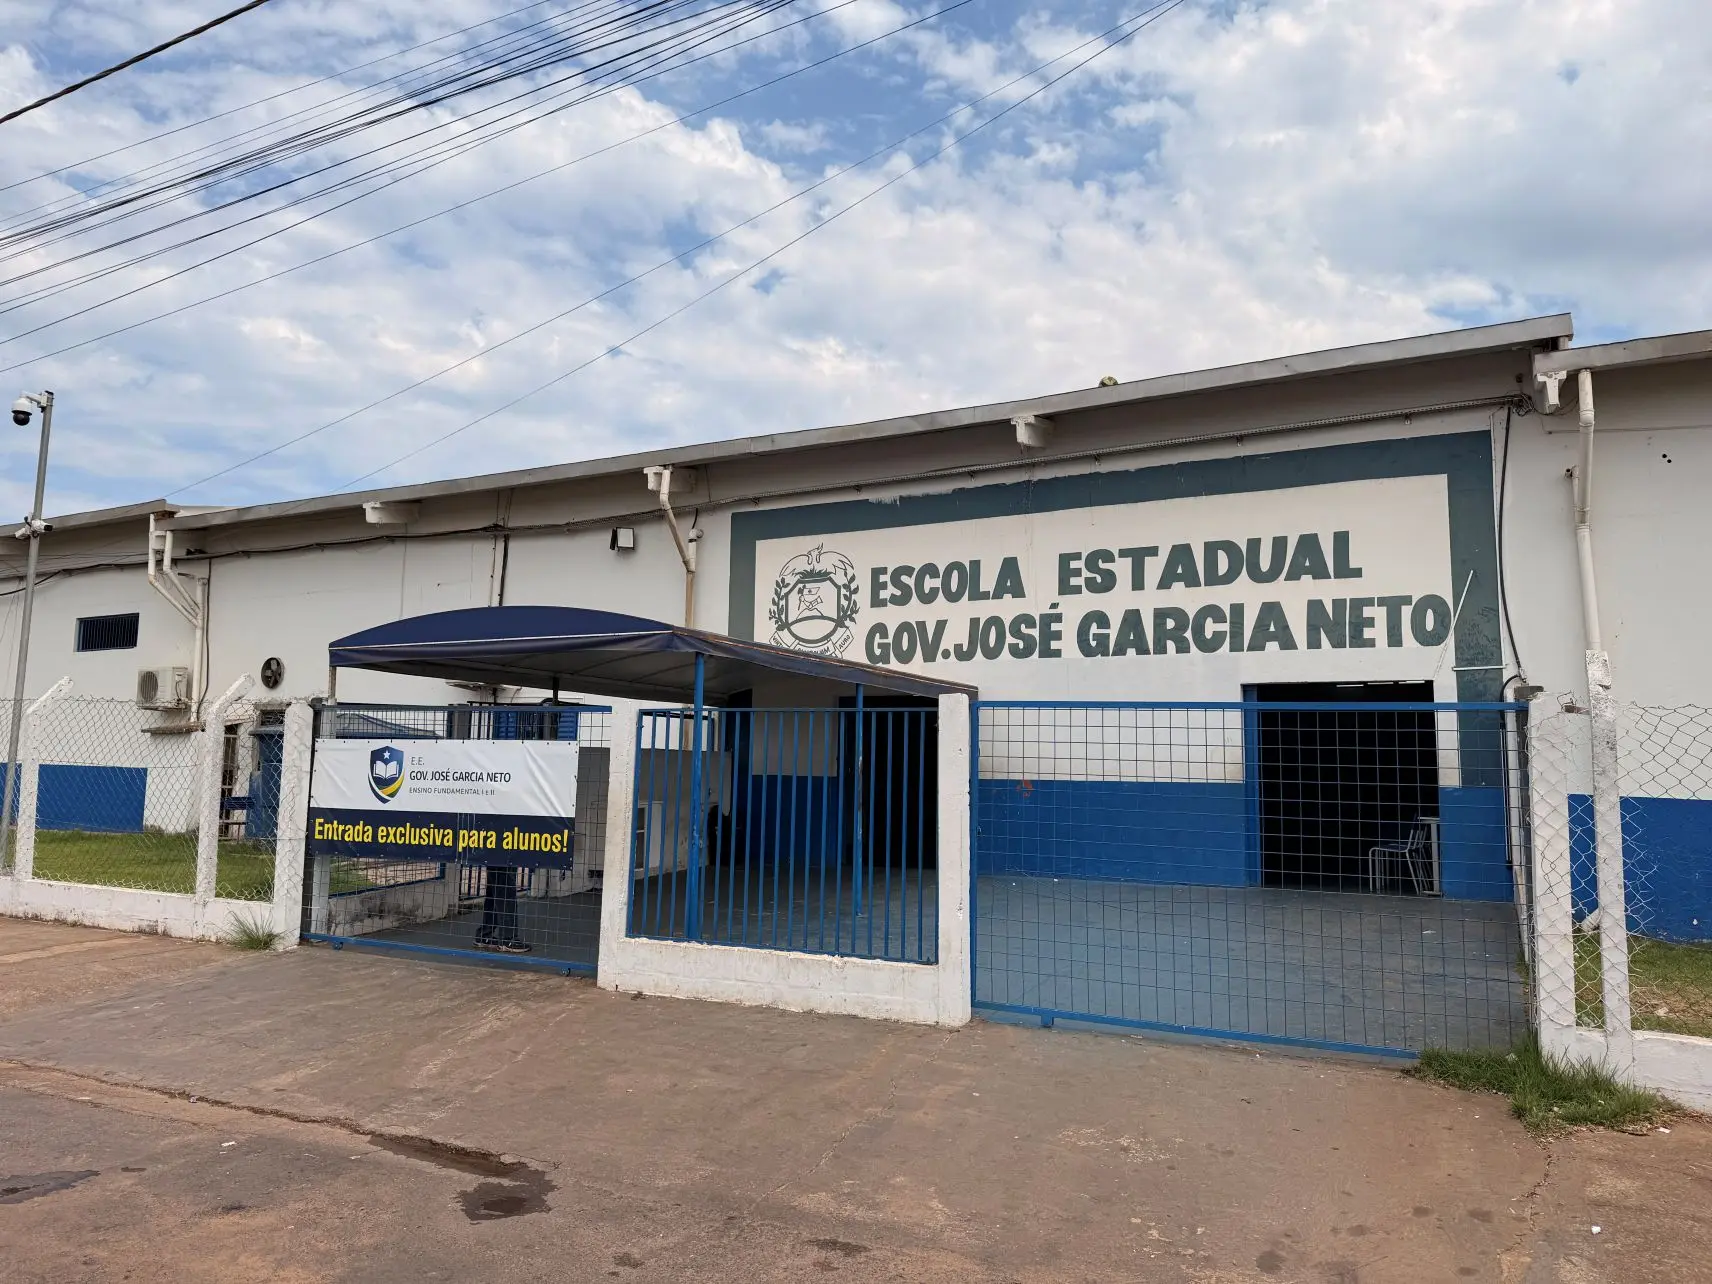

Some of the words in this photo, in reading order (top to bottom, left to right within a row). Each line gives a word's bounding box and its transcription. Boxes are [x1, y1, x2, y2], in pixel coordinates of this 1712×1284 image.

[870, 557, 1026, 608] ESCOLA
[1058, 531, 1362, 596] ESTADUAL
[1077, 601, 1298, 657] GARCIA
[1306, 594, 1451, 650] NETO
[410, 756, 425, 766] E.E.
[409, 770, 429, 781] GOV.
[430, 767, 451, 782] JOSÉ
[452, 771, 484, 782] GARCIA
[486, 772, 511, 783] NETO
[409, 786, 432, 794] ENSINO
[434, 787, 480, 795] FUNDAMENTAL
[314, 818, 372, 843] Entrada
[377, 823, 453, 847] exclusiva
[458, 829, 497, 851] para
[502, 827, 569, 853] alunos!
